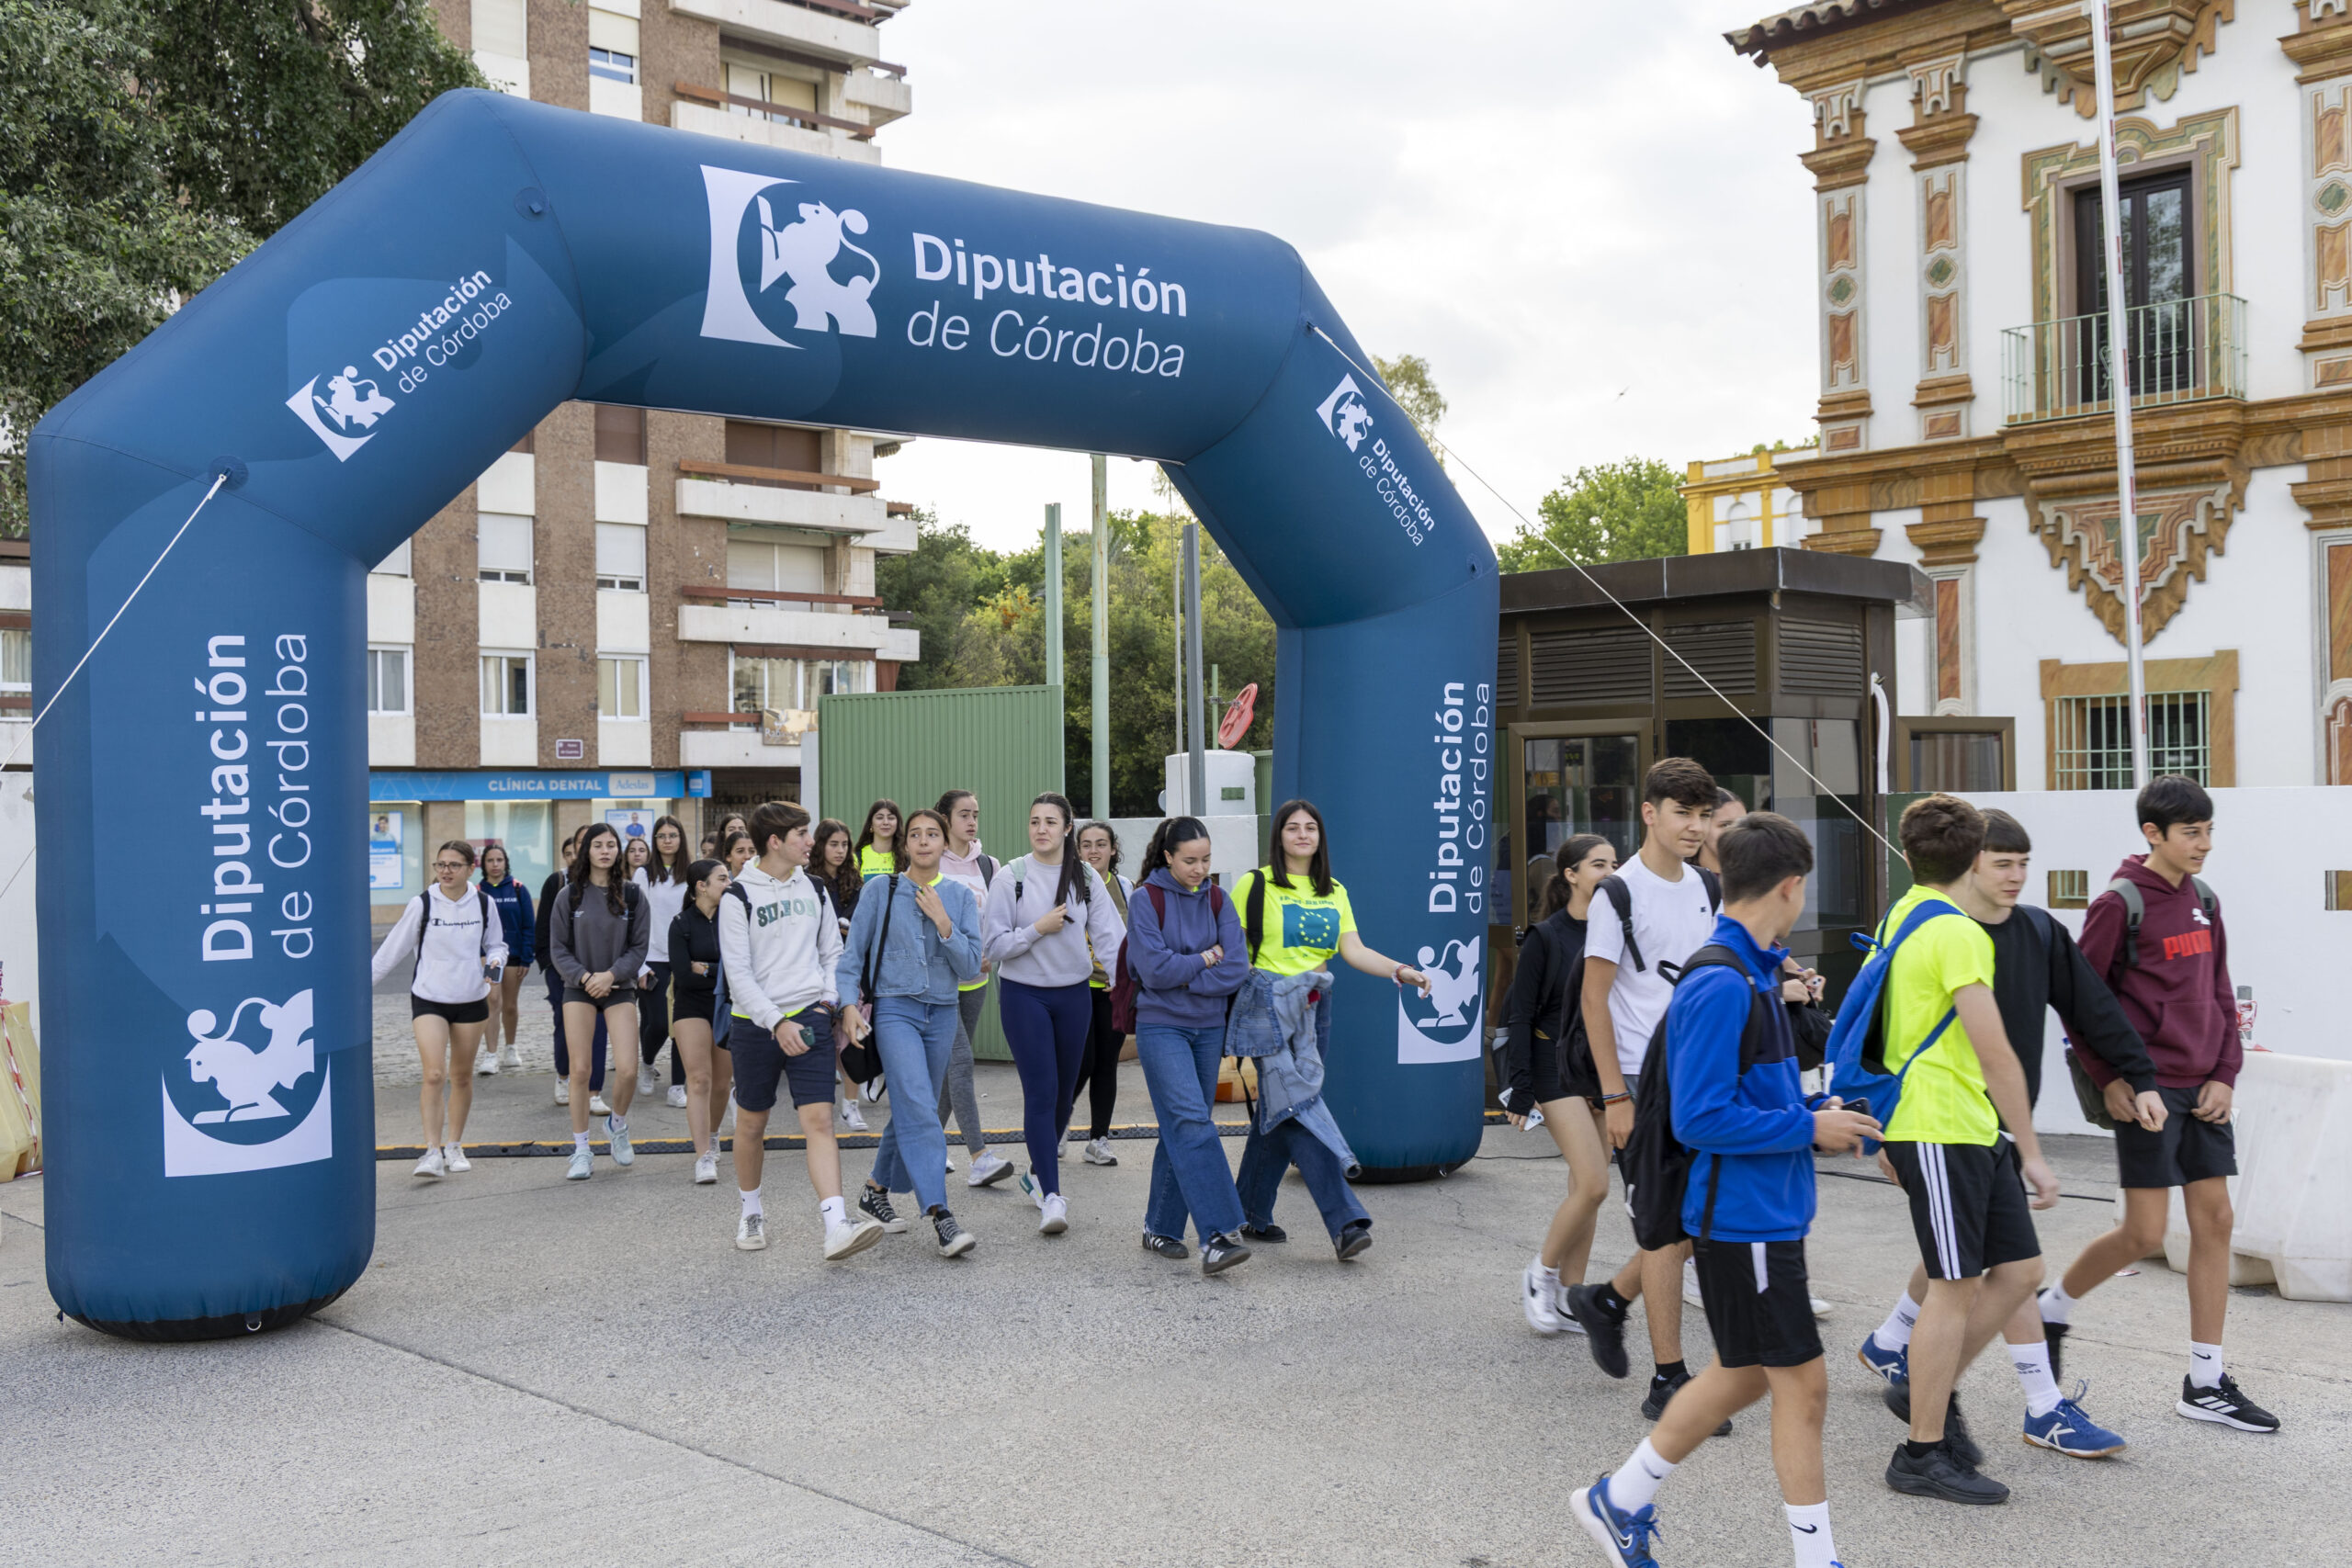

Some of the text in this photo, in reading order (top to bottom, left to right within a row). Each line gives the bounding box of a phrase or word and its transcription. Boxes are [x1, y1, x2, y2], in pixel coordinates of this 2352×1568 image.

[372, 270, 492, 372] Diputación
[912, 231, 1187, 317] Diputación
[399, 292, 512, 393] de Córdoba
[907, 299, 1184, 378] de Córdoba
[1359, 455, 1423, 547] de Córdoba
[1372, 438, 1435, 531] Diputación
[194, 635, 264, 962] Diputación
[265, 634, 313, 959] de Córdoba
[488, 777, 602, 792] CLÍNICA DENTAL
[1429, 682, 1464, 913] Diputación
[1464, 682, 1489, 914] de Córdoba
[2162, 929, 2212, 961] PUM
